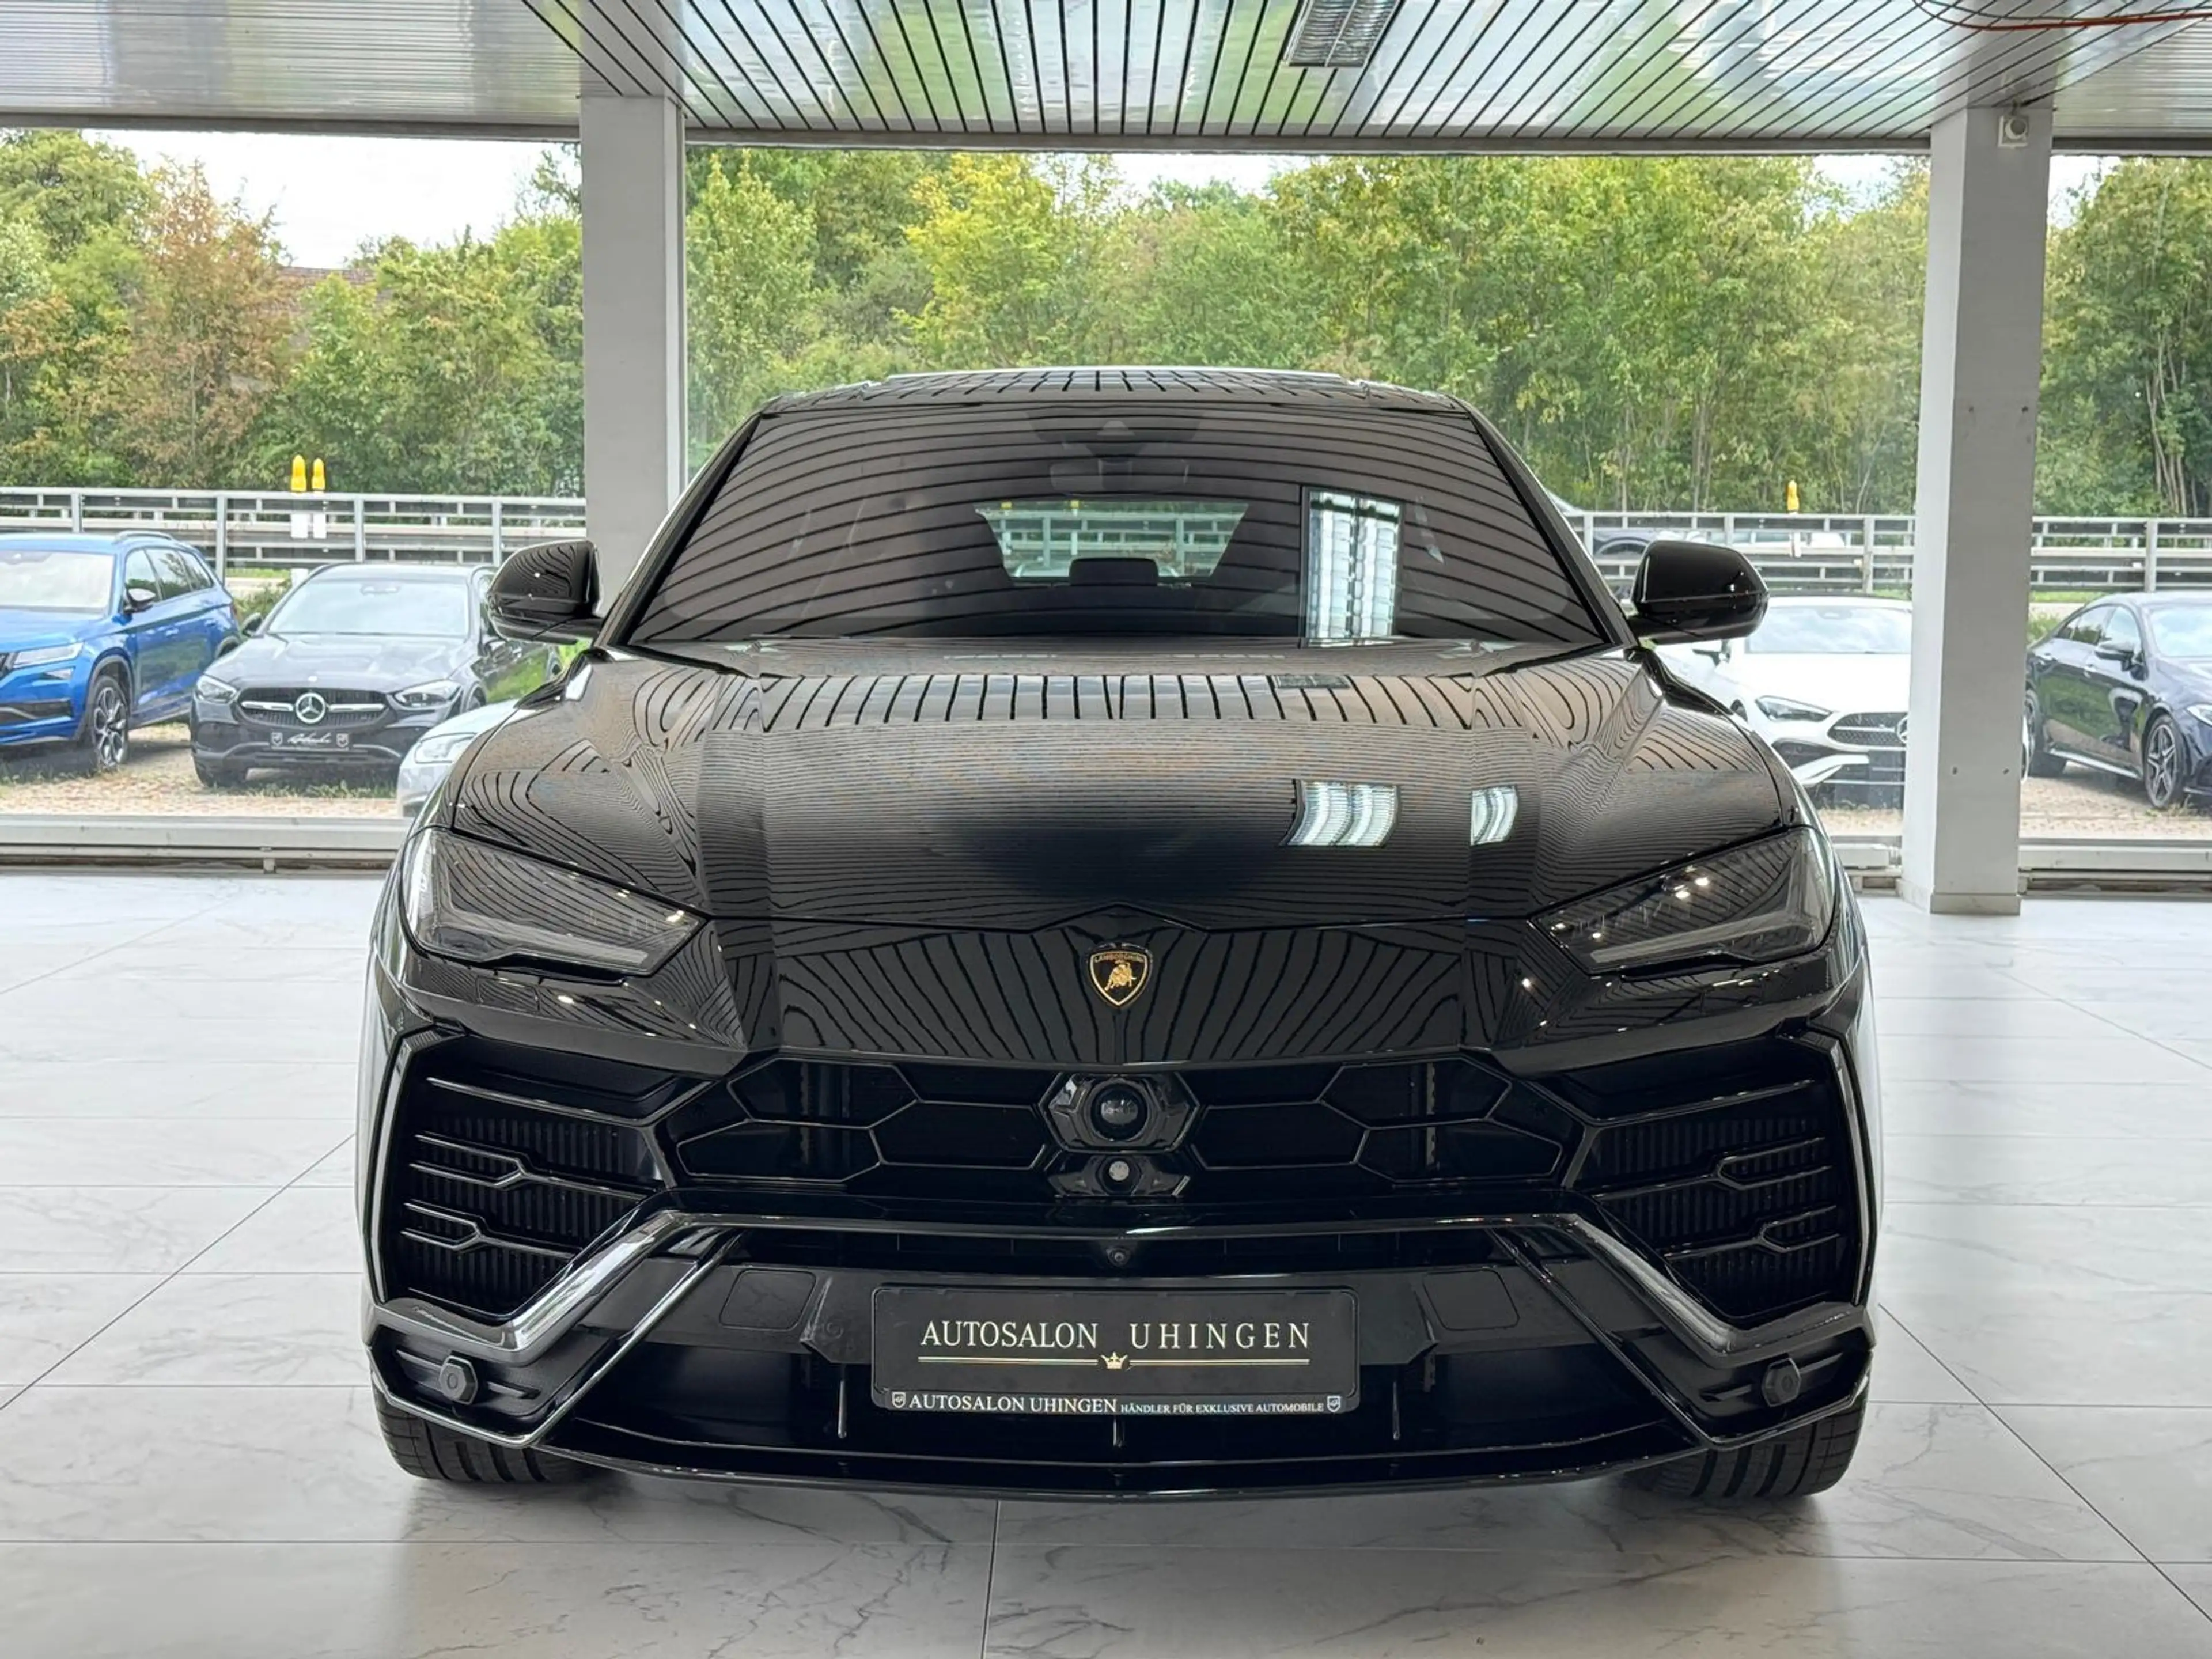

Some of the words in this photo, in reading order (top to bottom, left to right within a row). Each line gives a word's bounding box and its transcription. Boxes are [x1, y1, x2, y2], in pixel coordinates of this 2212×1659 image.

[921, 1321, 1098, 1349] AUTOSALON
[1130, 1323, 1309, 1349] UHINGEN
[909, 1394, 1024, 1411] AUTOSALON
[1030, 1397, 1117, 1412] UHINGEN
[1121, 1403, 1170, 1414] HÄNDLER
[1173, 1403, 1193, 1414] FÜR
[1196, 1404, 1253, 1413] EXKLUSIVE
[1256, 1403, 1324, 1412] AUTOMOBILE
